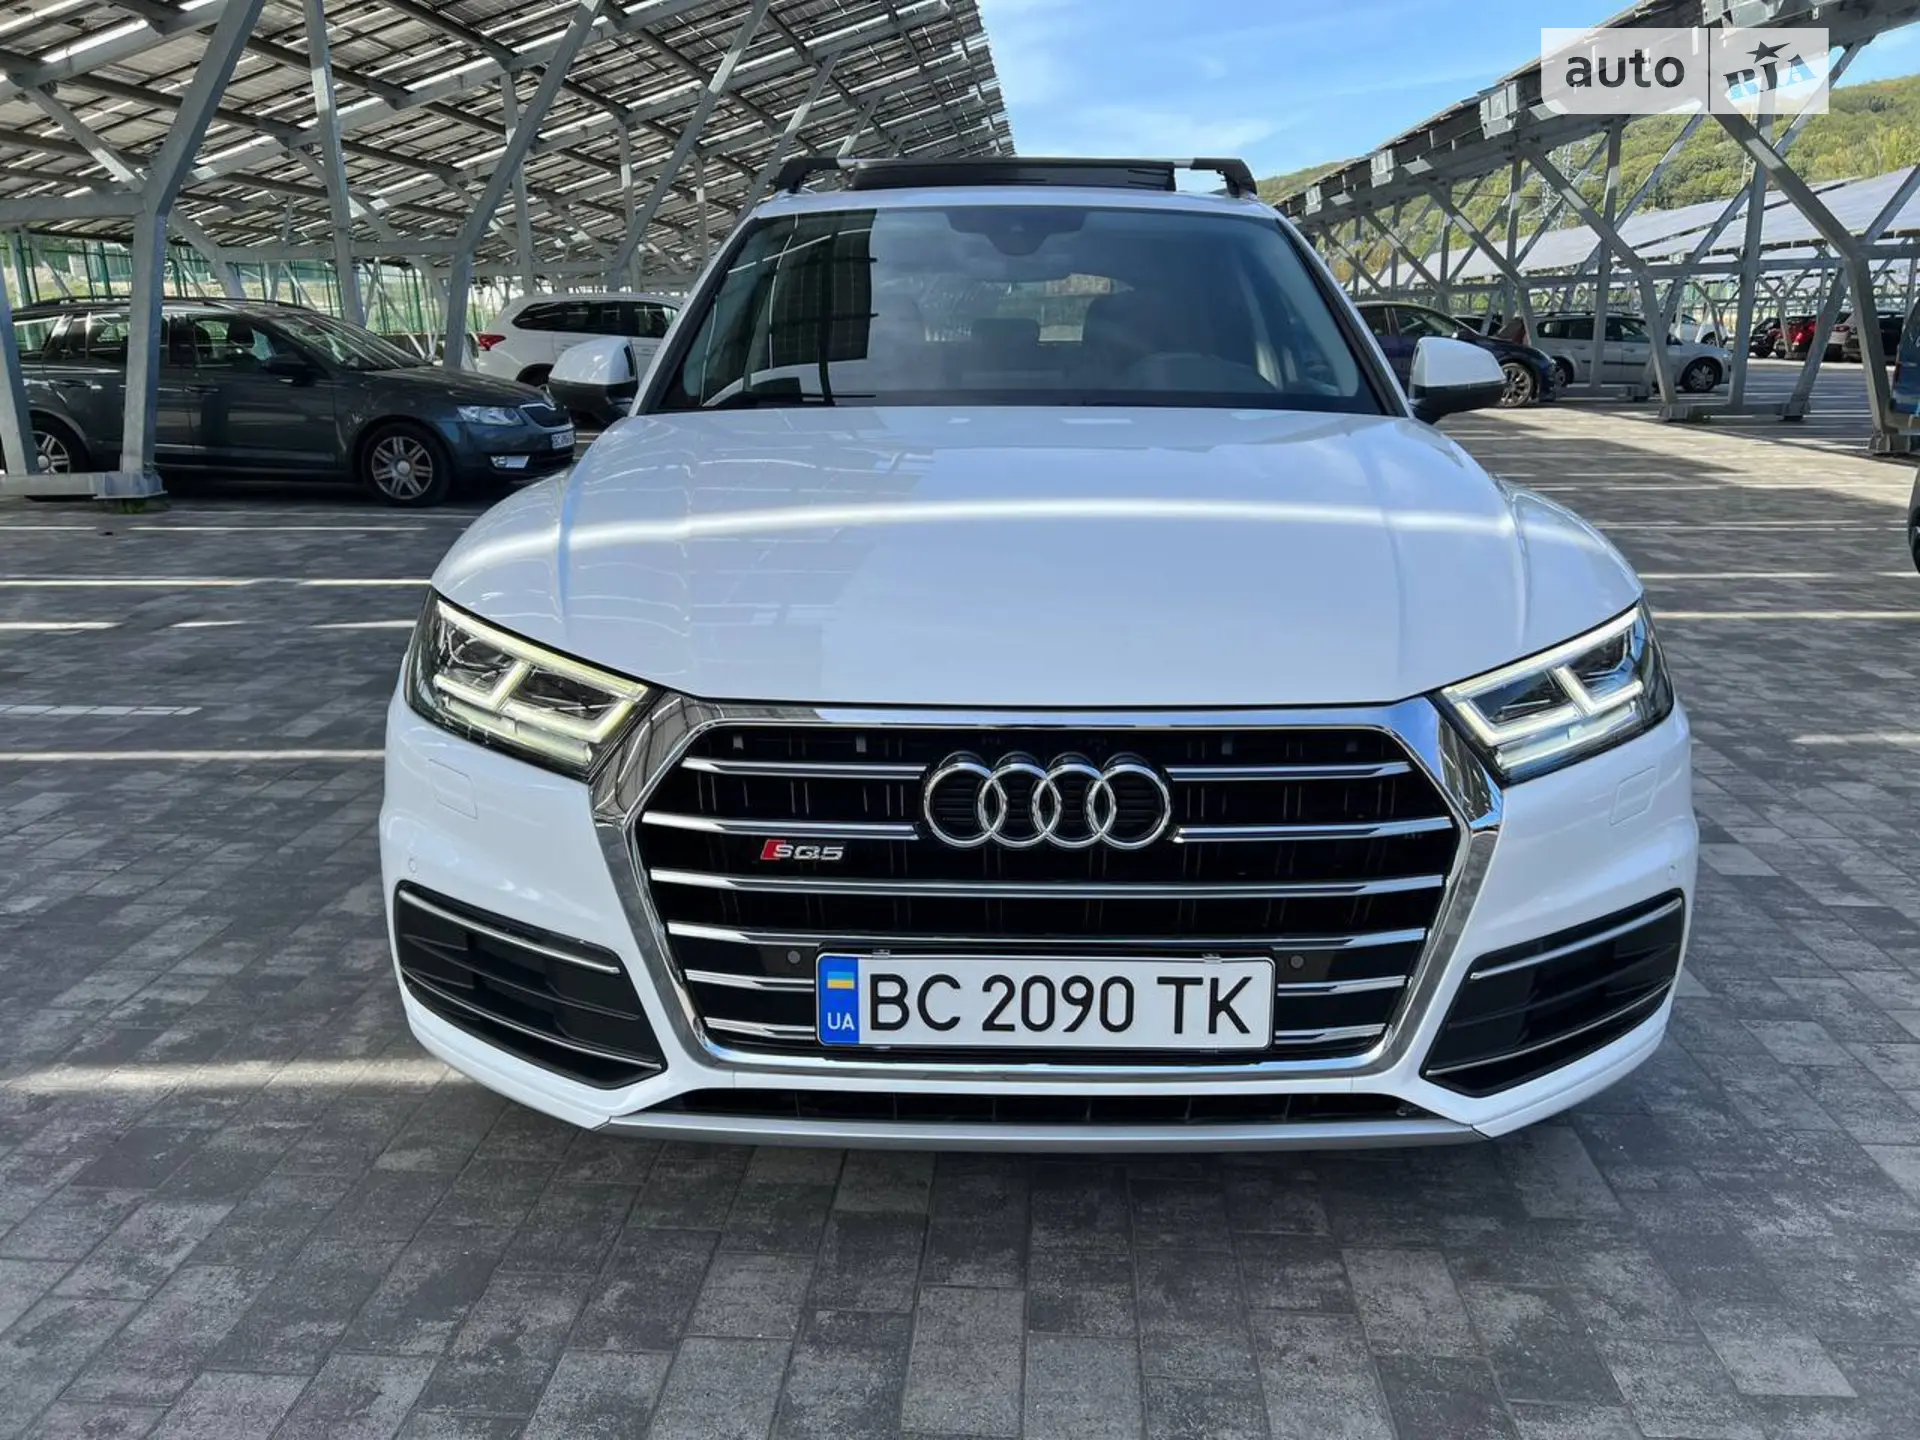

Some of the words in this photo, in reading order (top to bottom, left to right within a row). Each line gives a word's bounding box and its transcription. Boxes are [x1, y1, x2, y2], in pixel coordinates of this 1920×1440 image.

[773, 844, 844, 861] SQ5
[869, 972, 961, 1032] BC
[981, 973, 1135, 1034] 2090
[1156, 976, 1253, 1035] TK
[827, 1012, 856, 1031] UA
